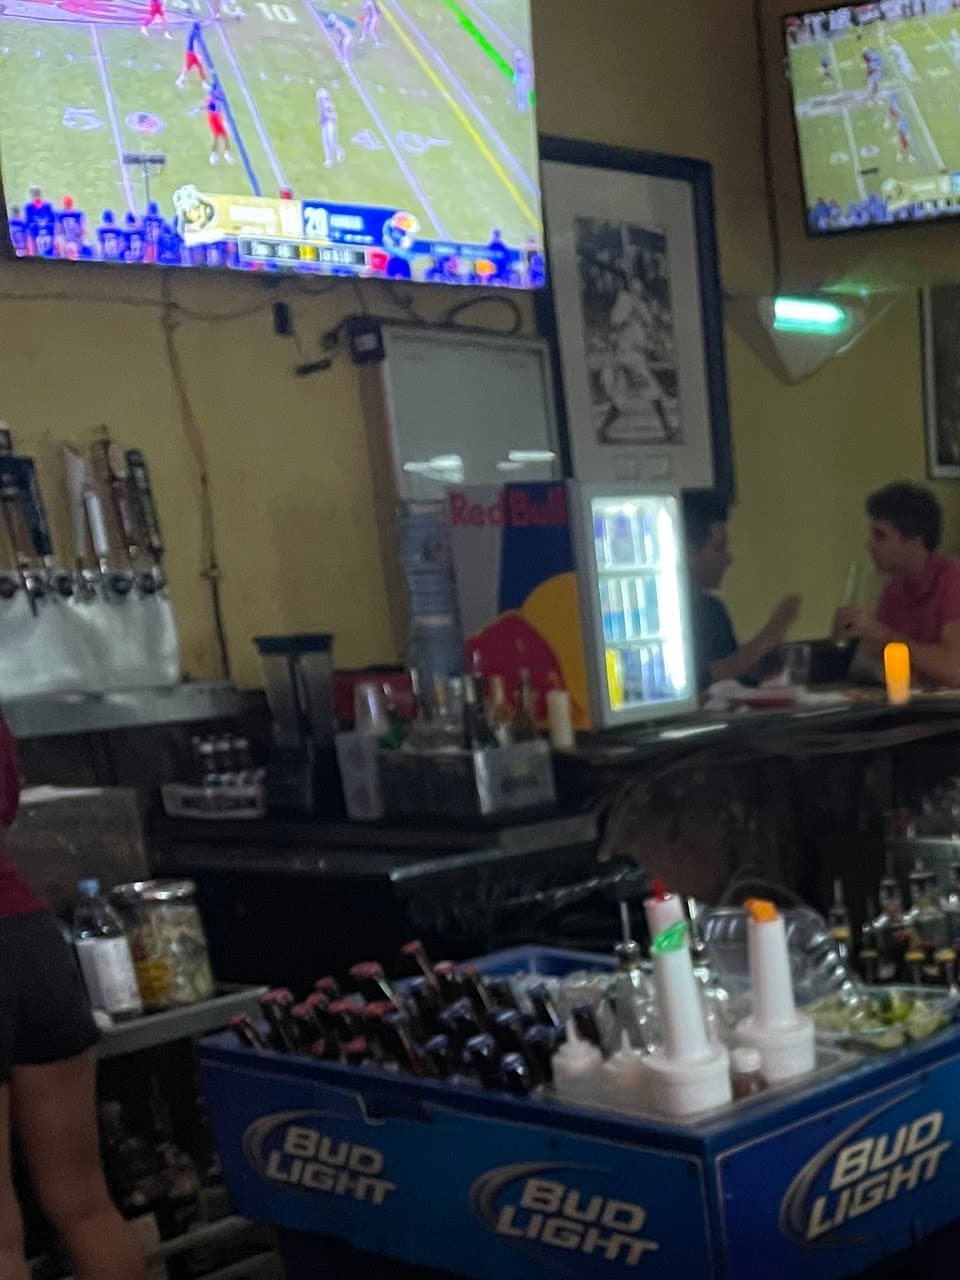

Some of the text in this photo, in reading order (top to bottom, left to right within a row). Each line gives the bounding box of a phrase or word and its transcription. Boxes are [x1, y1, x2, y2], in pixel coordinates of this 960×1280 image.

[447, 487, 567, 527] Red Bull
[264, 1150, 398, 1206] LIGHT
[283, 1125, 385, 1176] BUD
[829, 1109, 944, 1191] BUD
[520, 1177, 648, 1233] BUD
[805, 1141, 952, 1241] LIGHT
[497, 1205, 660, 1267] LIGHT
